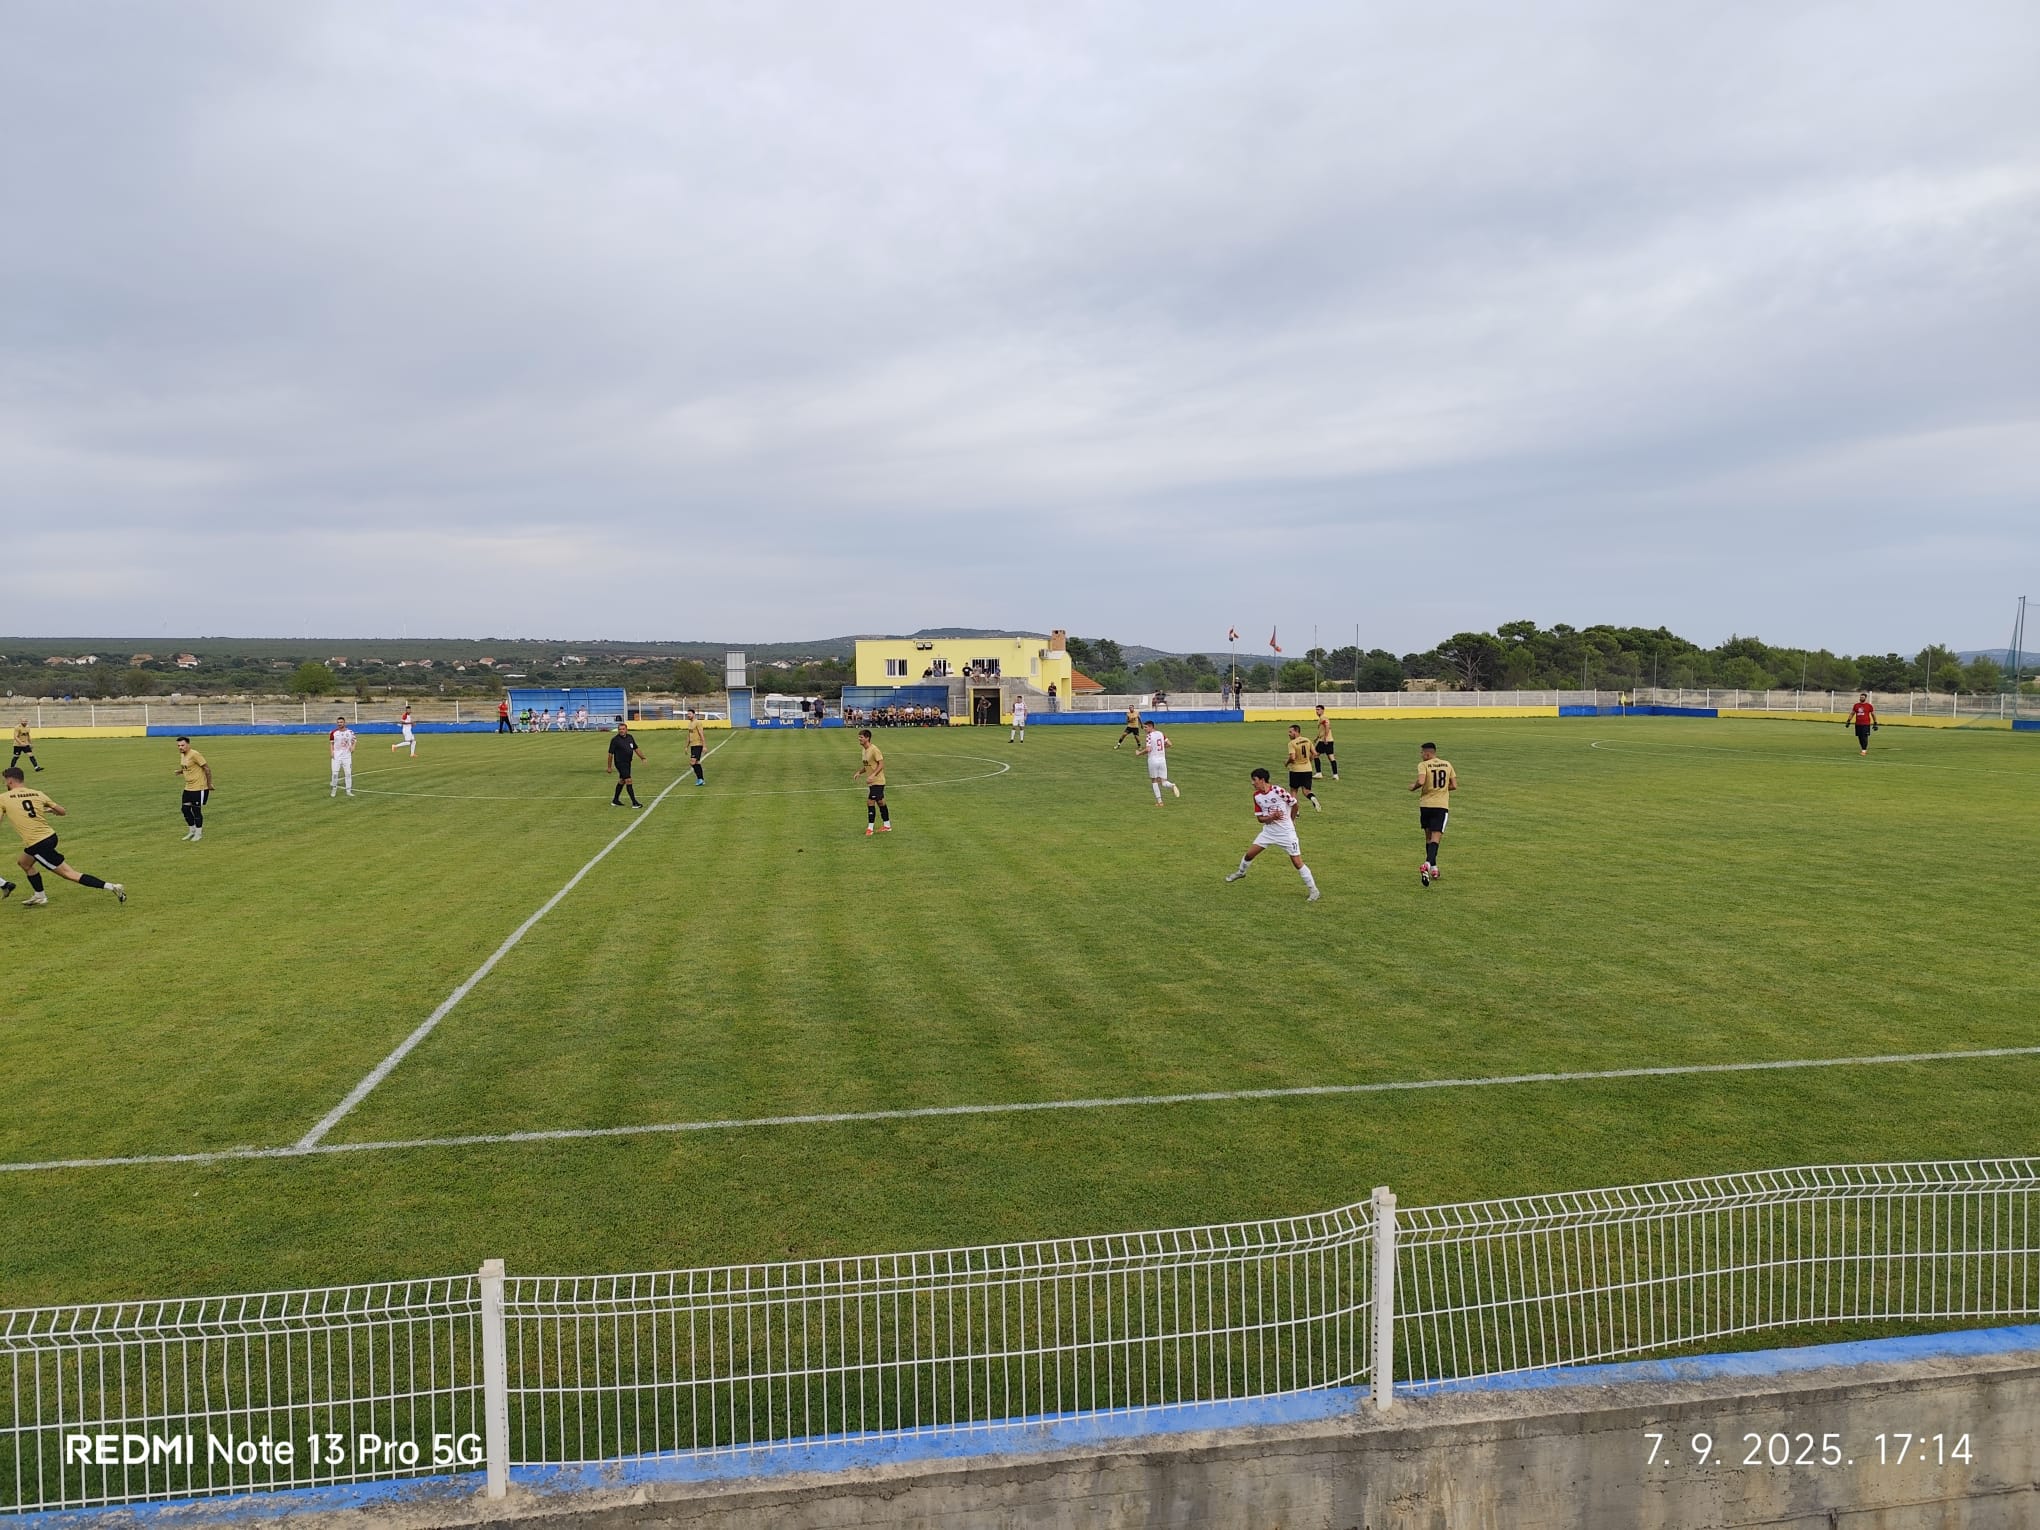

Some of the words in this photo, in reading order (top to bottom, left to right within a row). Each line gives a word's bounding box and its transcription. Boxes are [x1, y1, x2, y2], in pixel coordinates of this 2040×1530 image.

[1157, 739, 1163, 751] 9
[1301, 744, 1307, 758] 4
[1431, 769, 1447, 788] 18
[22, 799, 37, 818] 9
